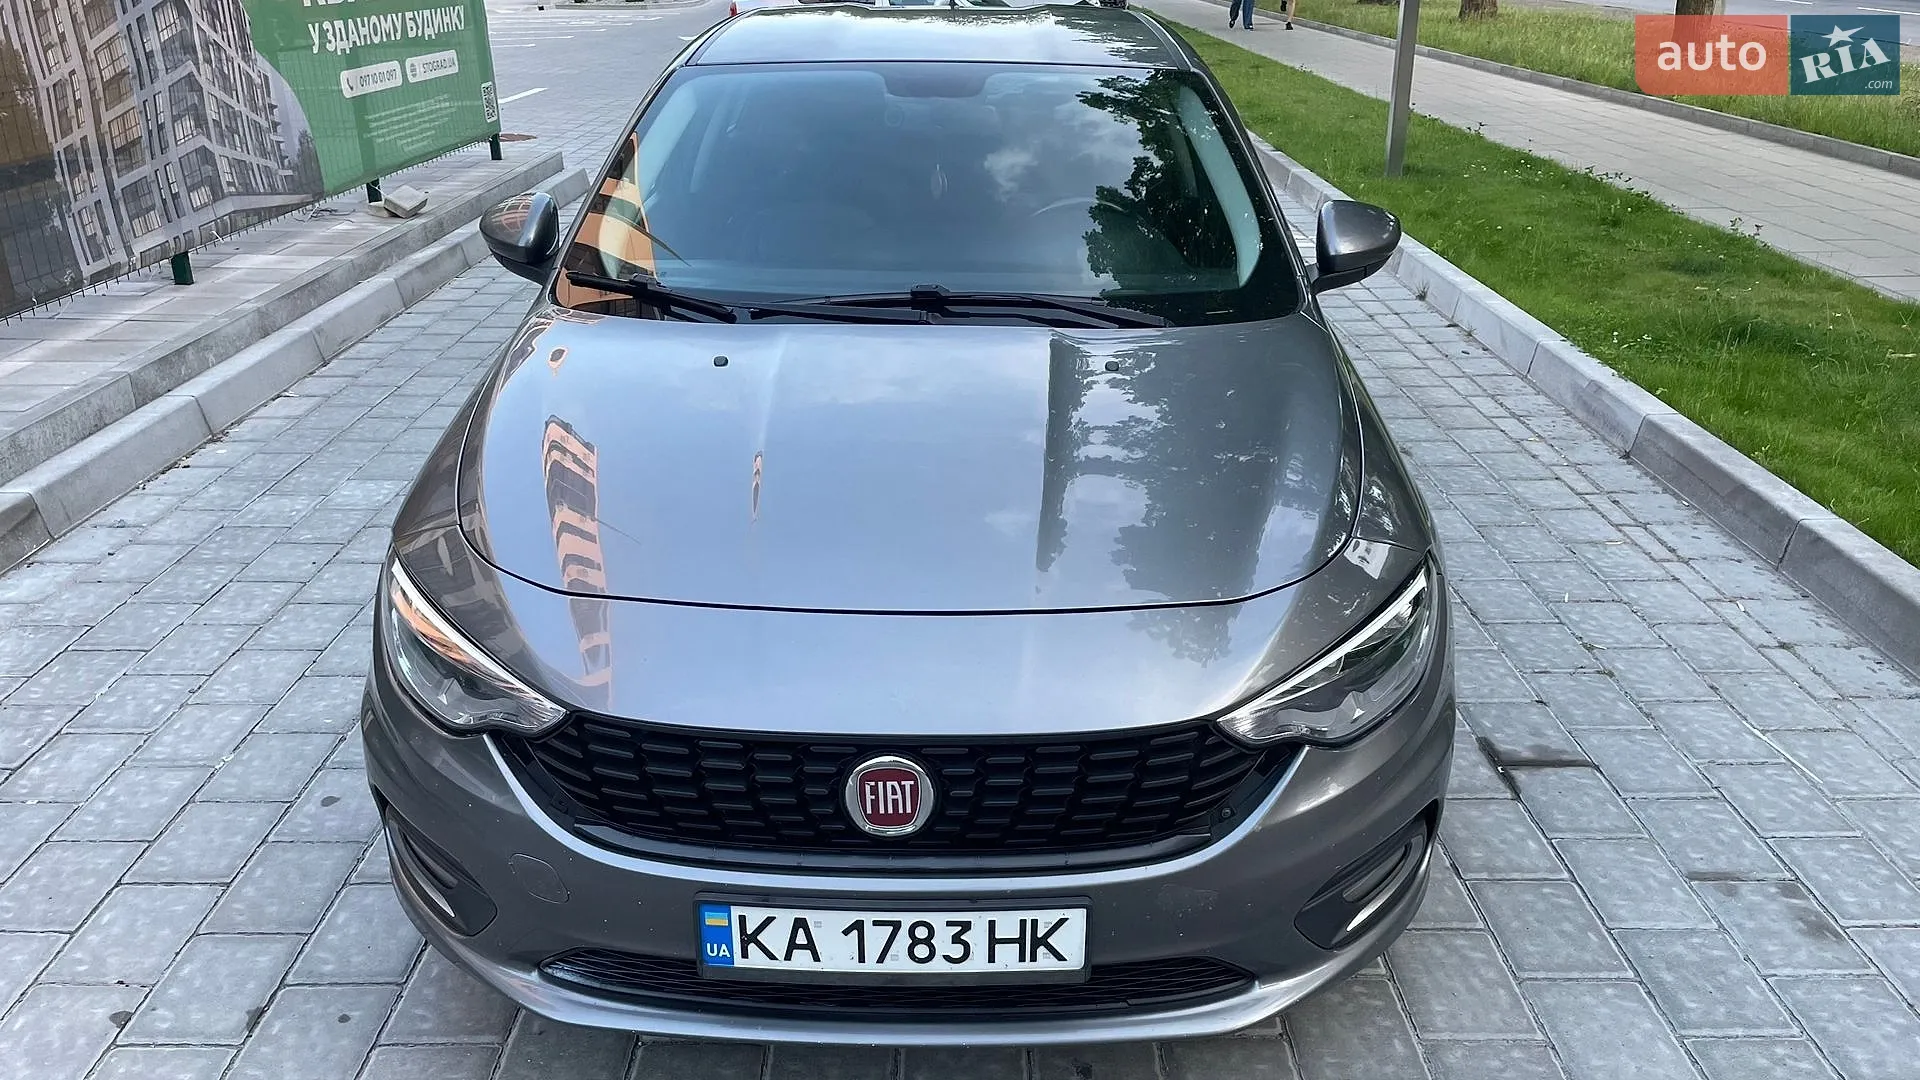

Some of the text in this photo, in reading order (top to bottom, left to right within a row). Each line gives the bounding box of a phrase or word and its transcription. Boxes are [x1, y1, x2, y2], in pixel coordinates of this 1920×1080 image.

[308, 5, 465, 55] У ЗДАНОМУ БУДИНКУ
[864, 780, 915, 815] FIAT
[706, 943, 731, 958] UA
[737, 914, 1071, 965] KA 1783 HK
